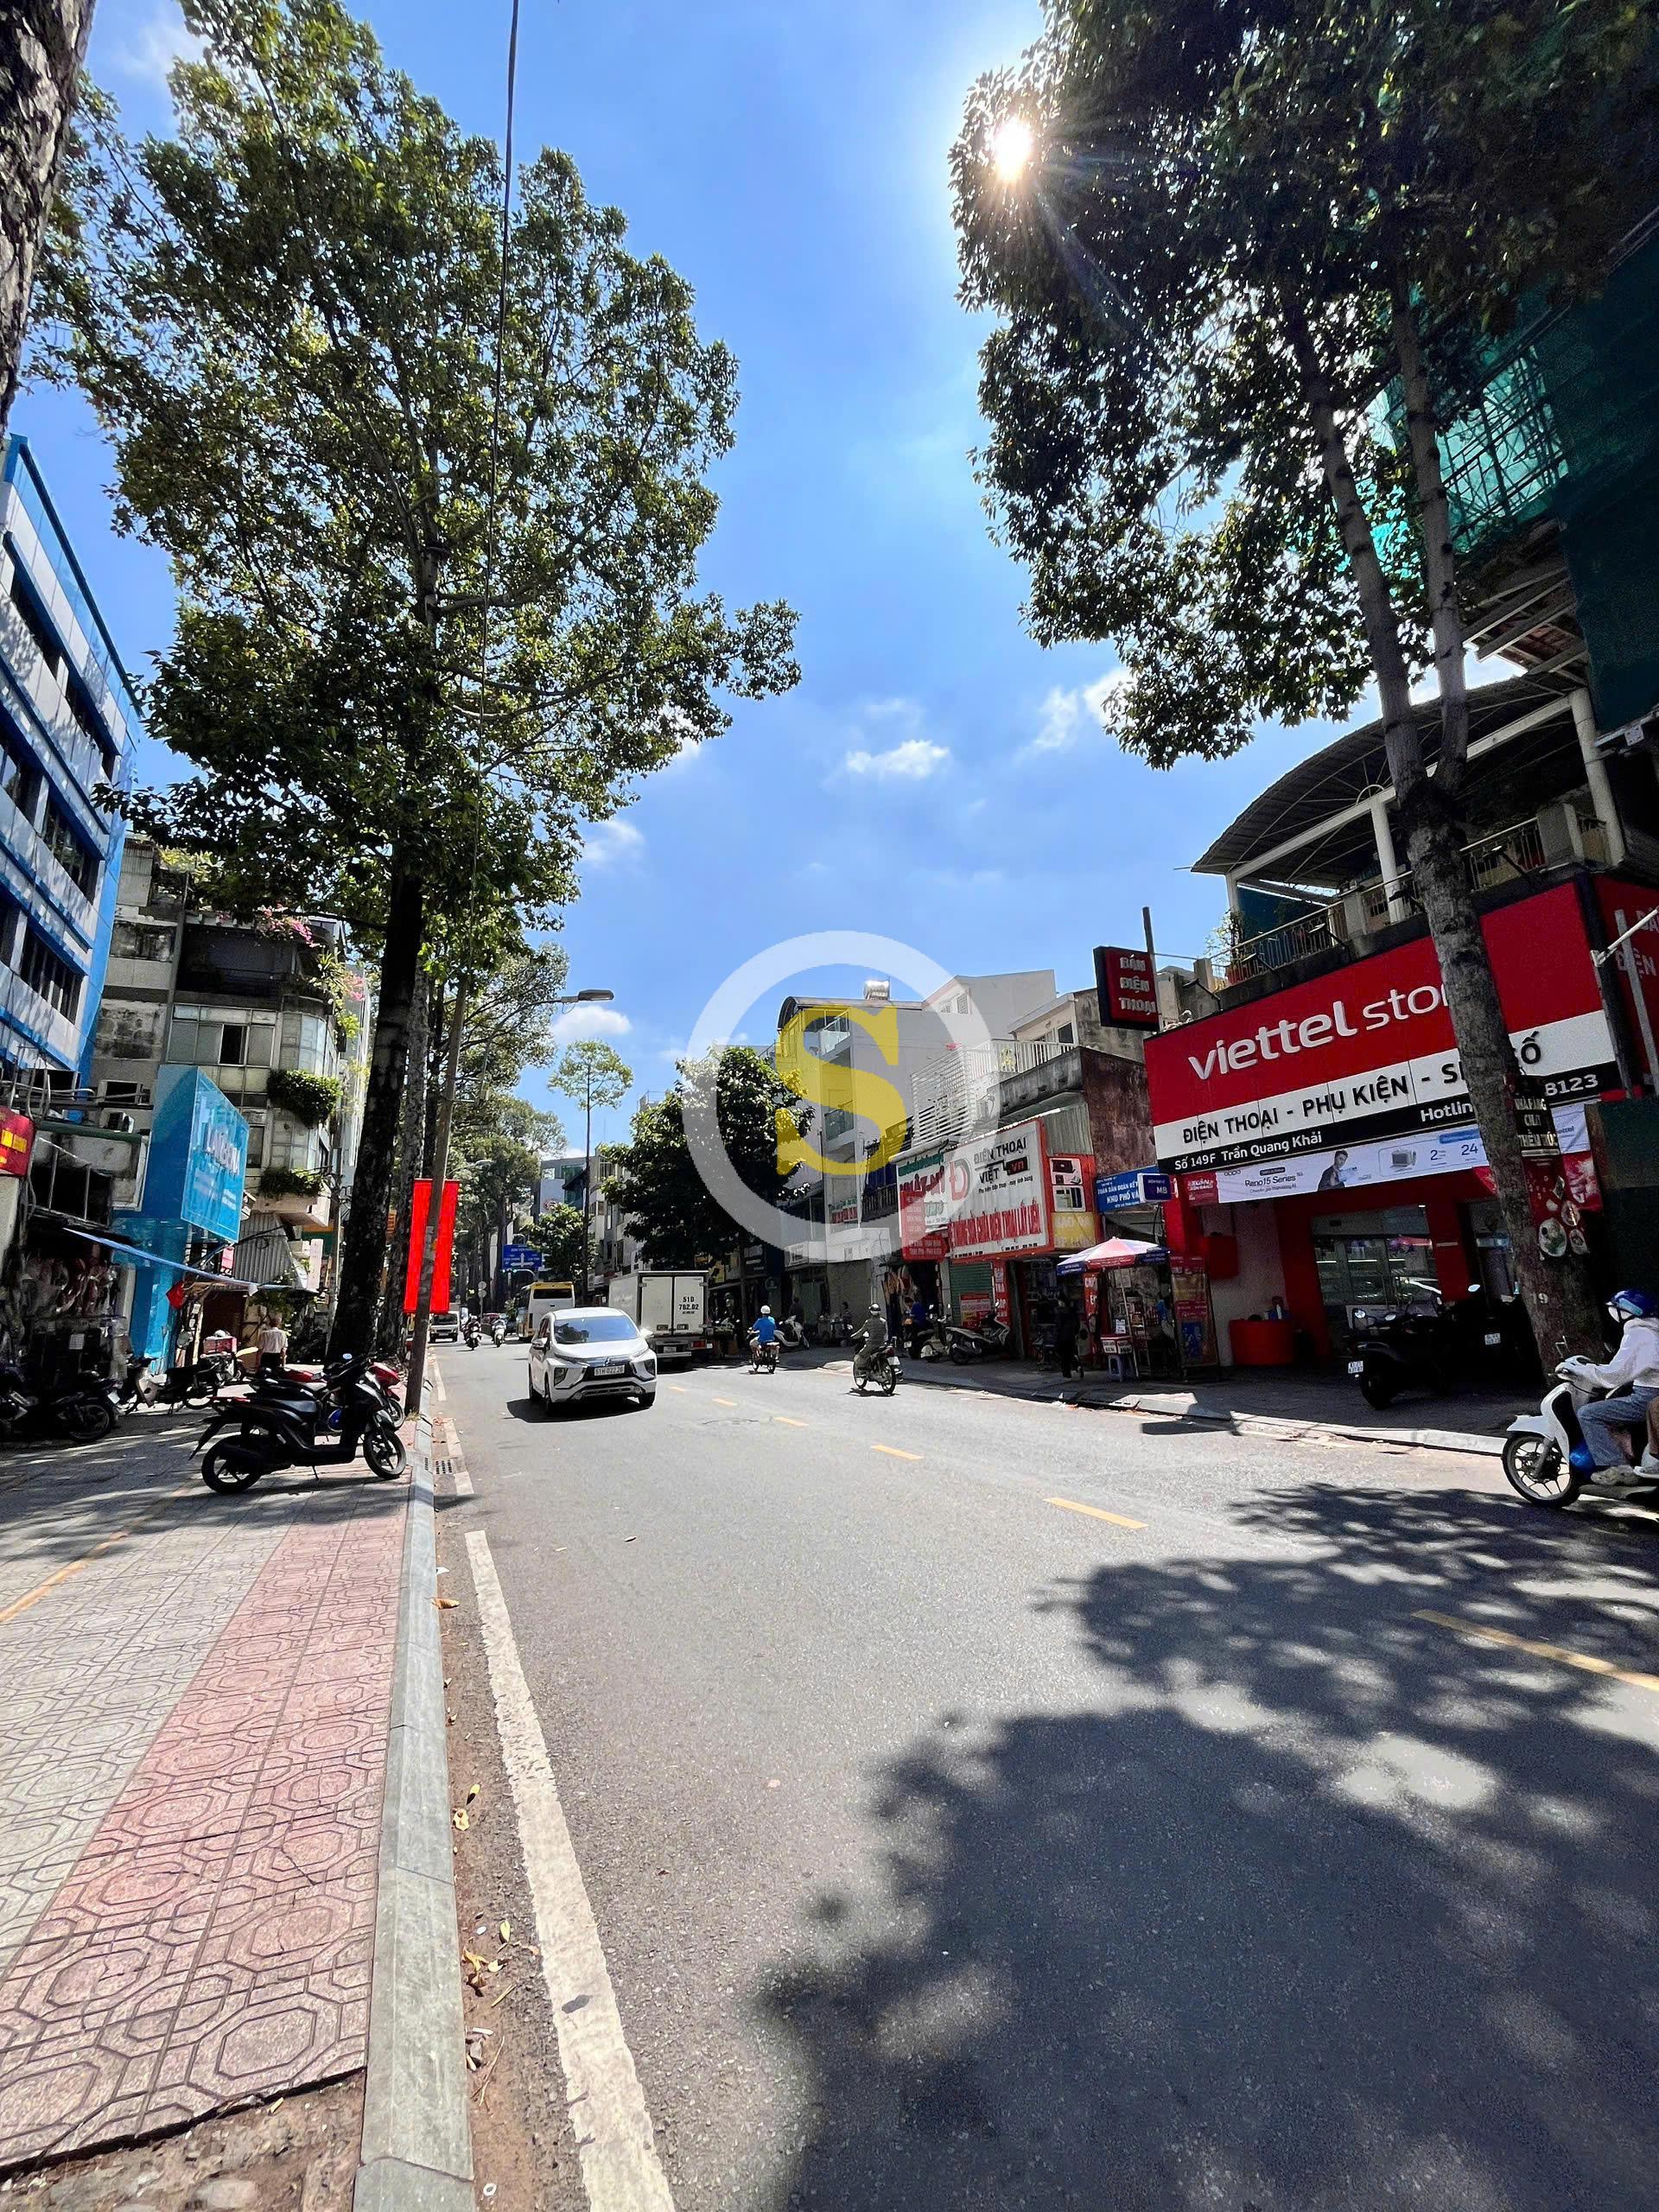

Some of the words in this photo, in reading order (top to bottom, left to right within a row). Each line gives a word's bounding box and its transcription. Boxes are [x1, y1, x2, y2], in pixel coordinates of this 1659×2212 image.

[1120, 954, 1146, 971] BÁN
[1616, 948, 1657, 979] ĐỆN
[1120, 976, 1150, 993] ĐIỆN
[1118, 997, 1157, 1015] THOẠI
[1188, 1001, 1357, 1080] viettel
[1363, 983, 1449, 1031] sto
[1183, 1121, 1218, 1145] ĐIỆN
[1224, 1107, 1279, 1135] THOẠI
[1302, 1090, 1345, 1117] PHỤ
[1353, 1074, 1408, 1103] KIỆN
[1442, 1061, 1466, 1084] SI
[1521, 1031, 1541, 1065] Ố
[1175, 1154, 1188, 1171] Số
[1191, 1153, 1216, 1167] 149F
[1221, 1146, 1248, 1161] Trần
[1250, 1141, 1290, 1158] Quang
[1293, 1131, 1322, 1148] Khải
[1421, 1101, 1473, 1122] Hotlin
[995, 1137, 1027, 1155] THOẠI
[1430, 1149, 1438, 1160] 2
[1461, 1143, 1478, 1155] 24
[979, 1166, 1000, 1184] VIỆT
